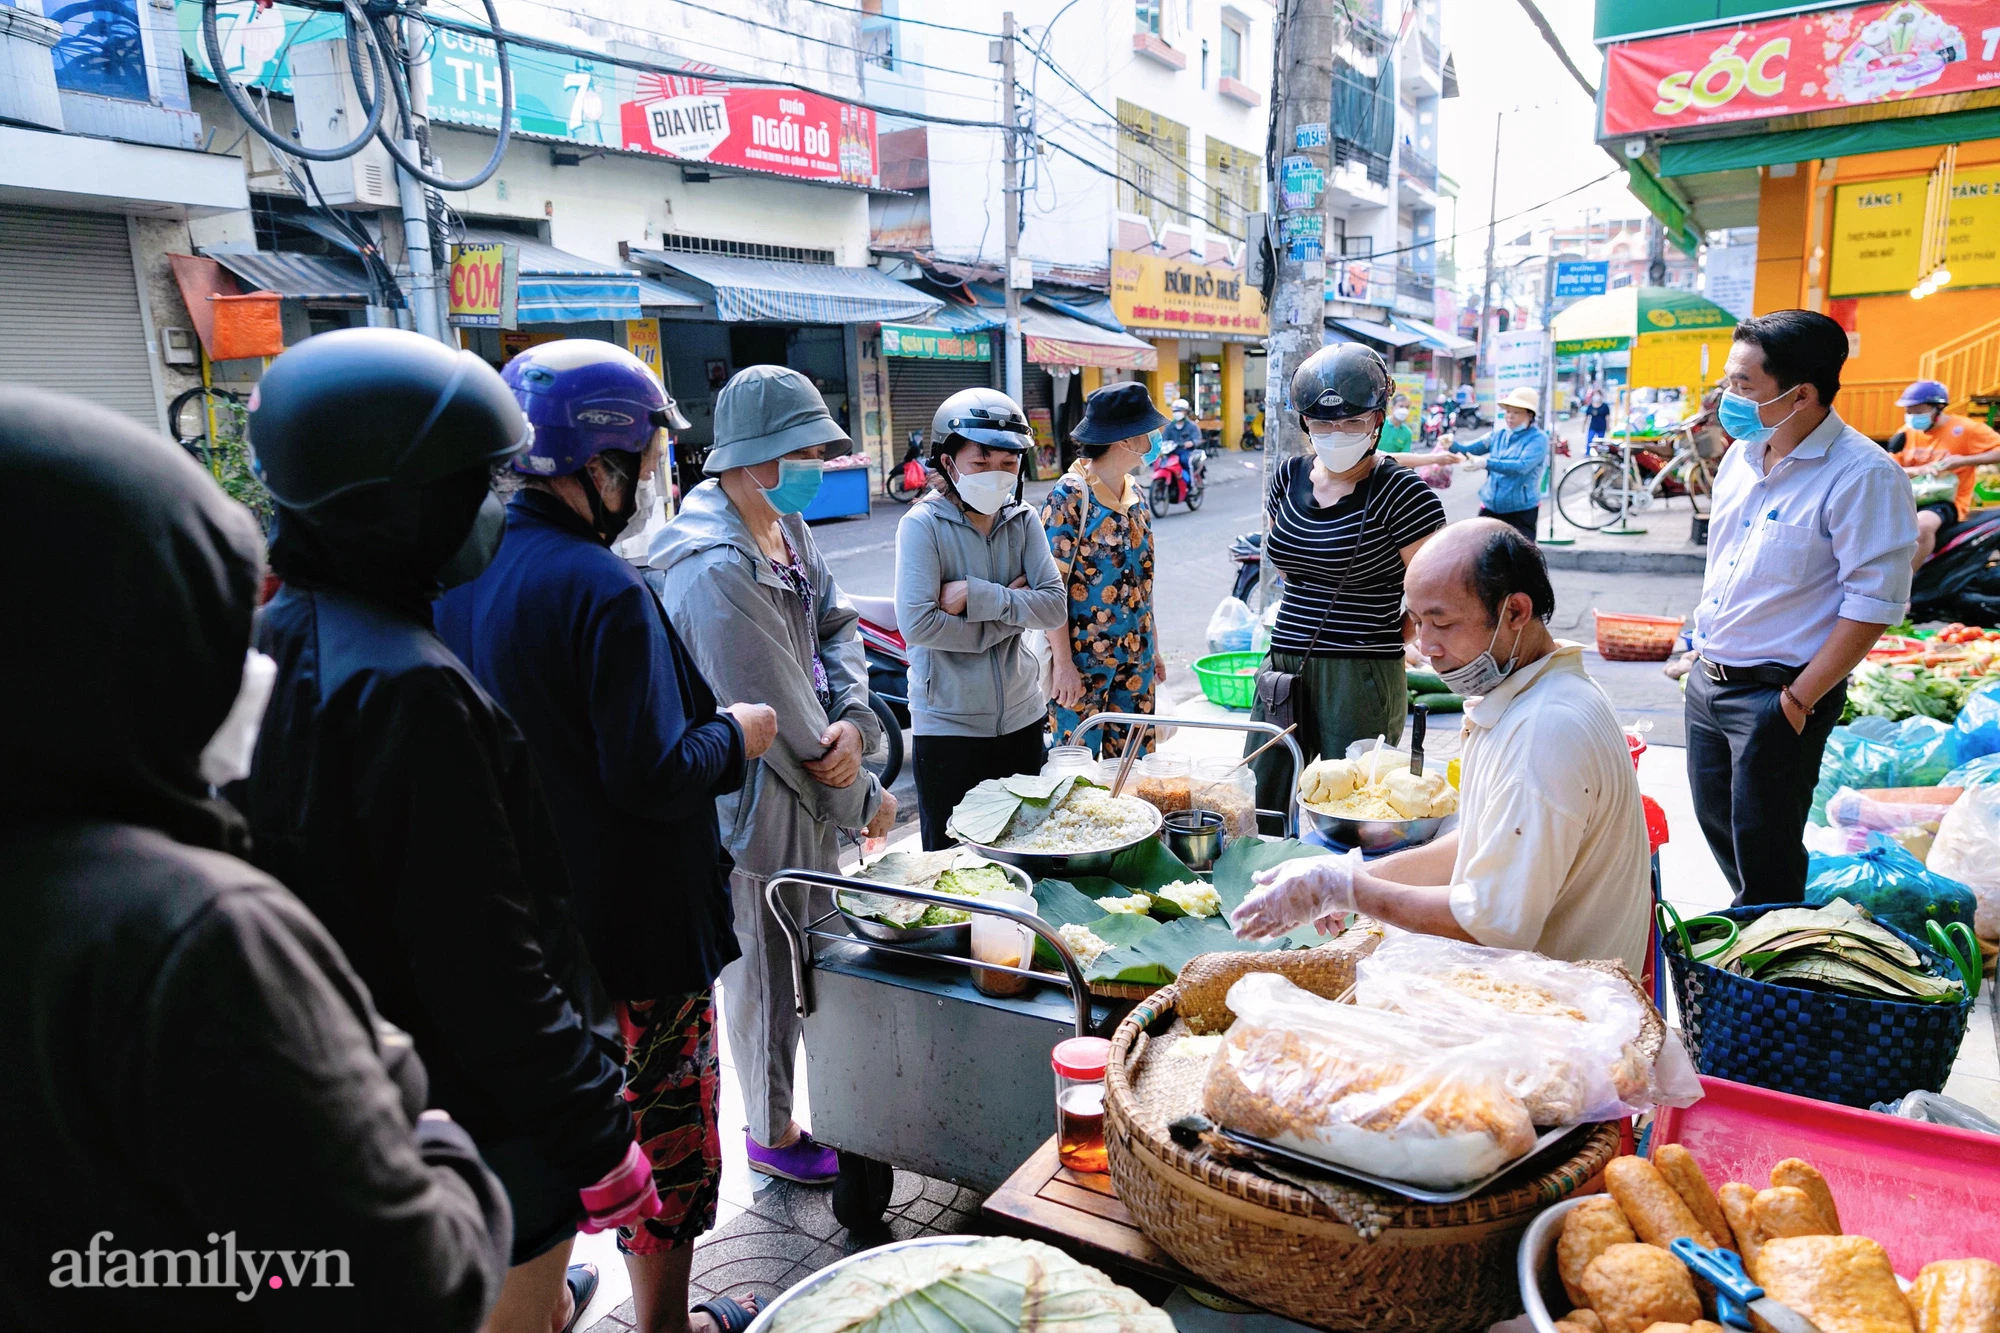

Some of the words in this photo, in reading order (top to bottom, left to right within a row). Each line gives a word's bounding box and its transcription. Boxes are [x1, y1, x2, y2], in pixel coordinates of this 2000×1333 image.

[651, 109, 687, 138] BIA
[684, 100, 722, 136] VIỆT
[752, 114, 801, 153] NGÓI
[803, 121, 831, 158] ĐỎ
[450, 254, 503, 309] CƠM
[1164, 266, 1191, 295] BÚN
[1194, 270, 1214, 298] BÒ
